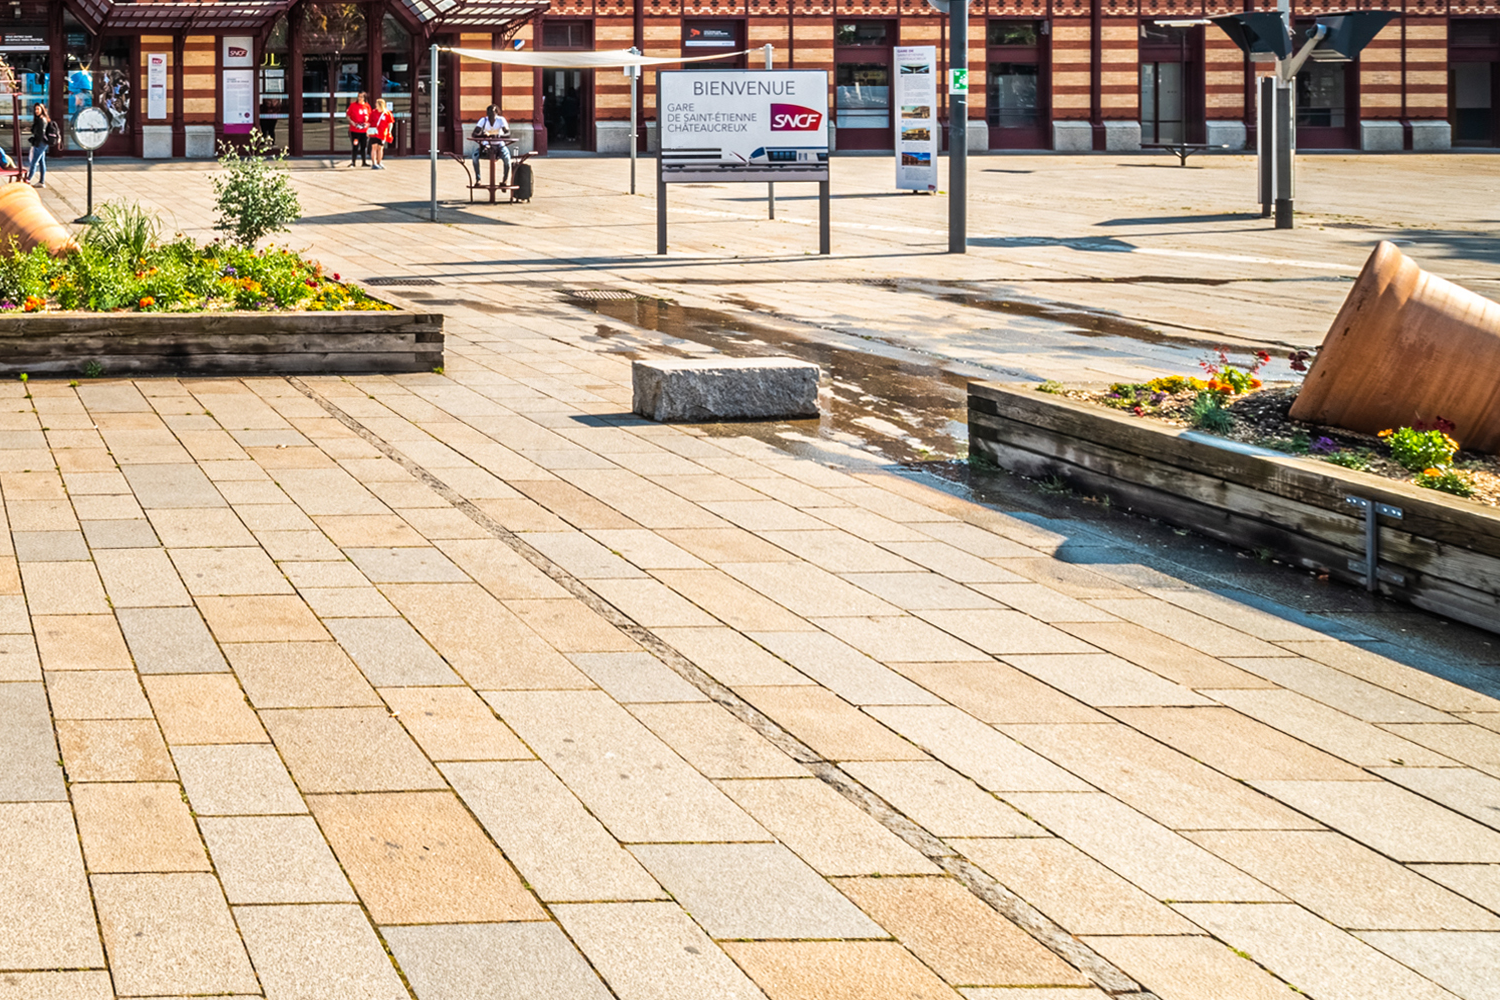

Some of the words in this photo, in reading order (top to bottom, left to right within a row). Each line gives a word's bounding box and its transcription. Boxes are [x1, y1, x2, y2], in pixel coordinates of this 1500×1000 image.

[693, 81, 796, 96] BIENVENUE
[667, 103, 695, 112] GARE
[667, 113, 681, 122] DE
[684, 111, 757, 122] SAINT-ÉTIENNE
[772, 114, 820, 128] SNCF
[667, 121, 748, 133] CHÂTEAUCREUX
